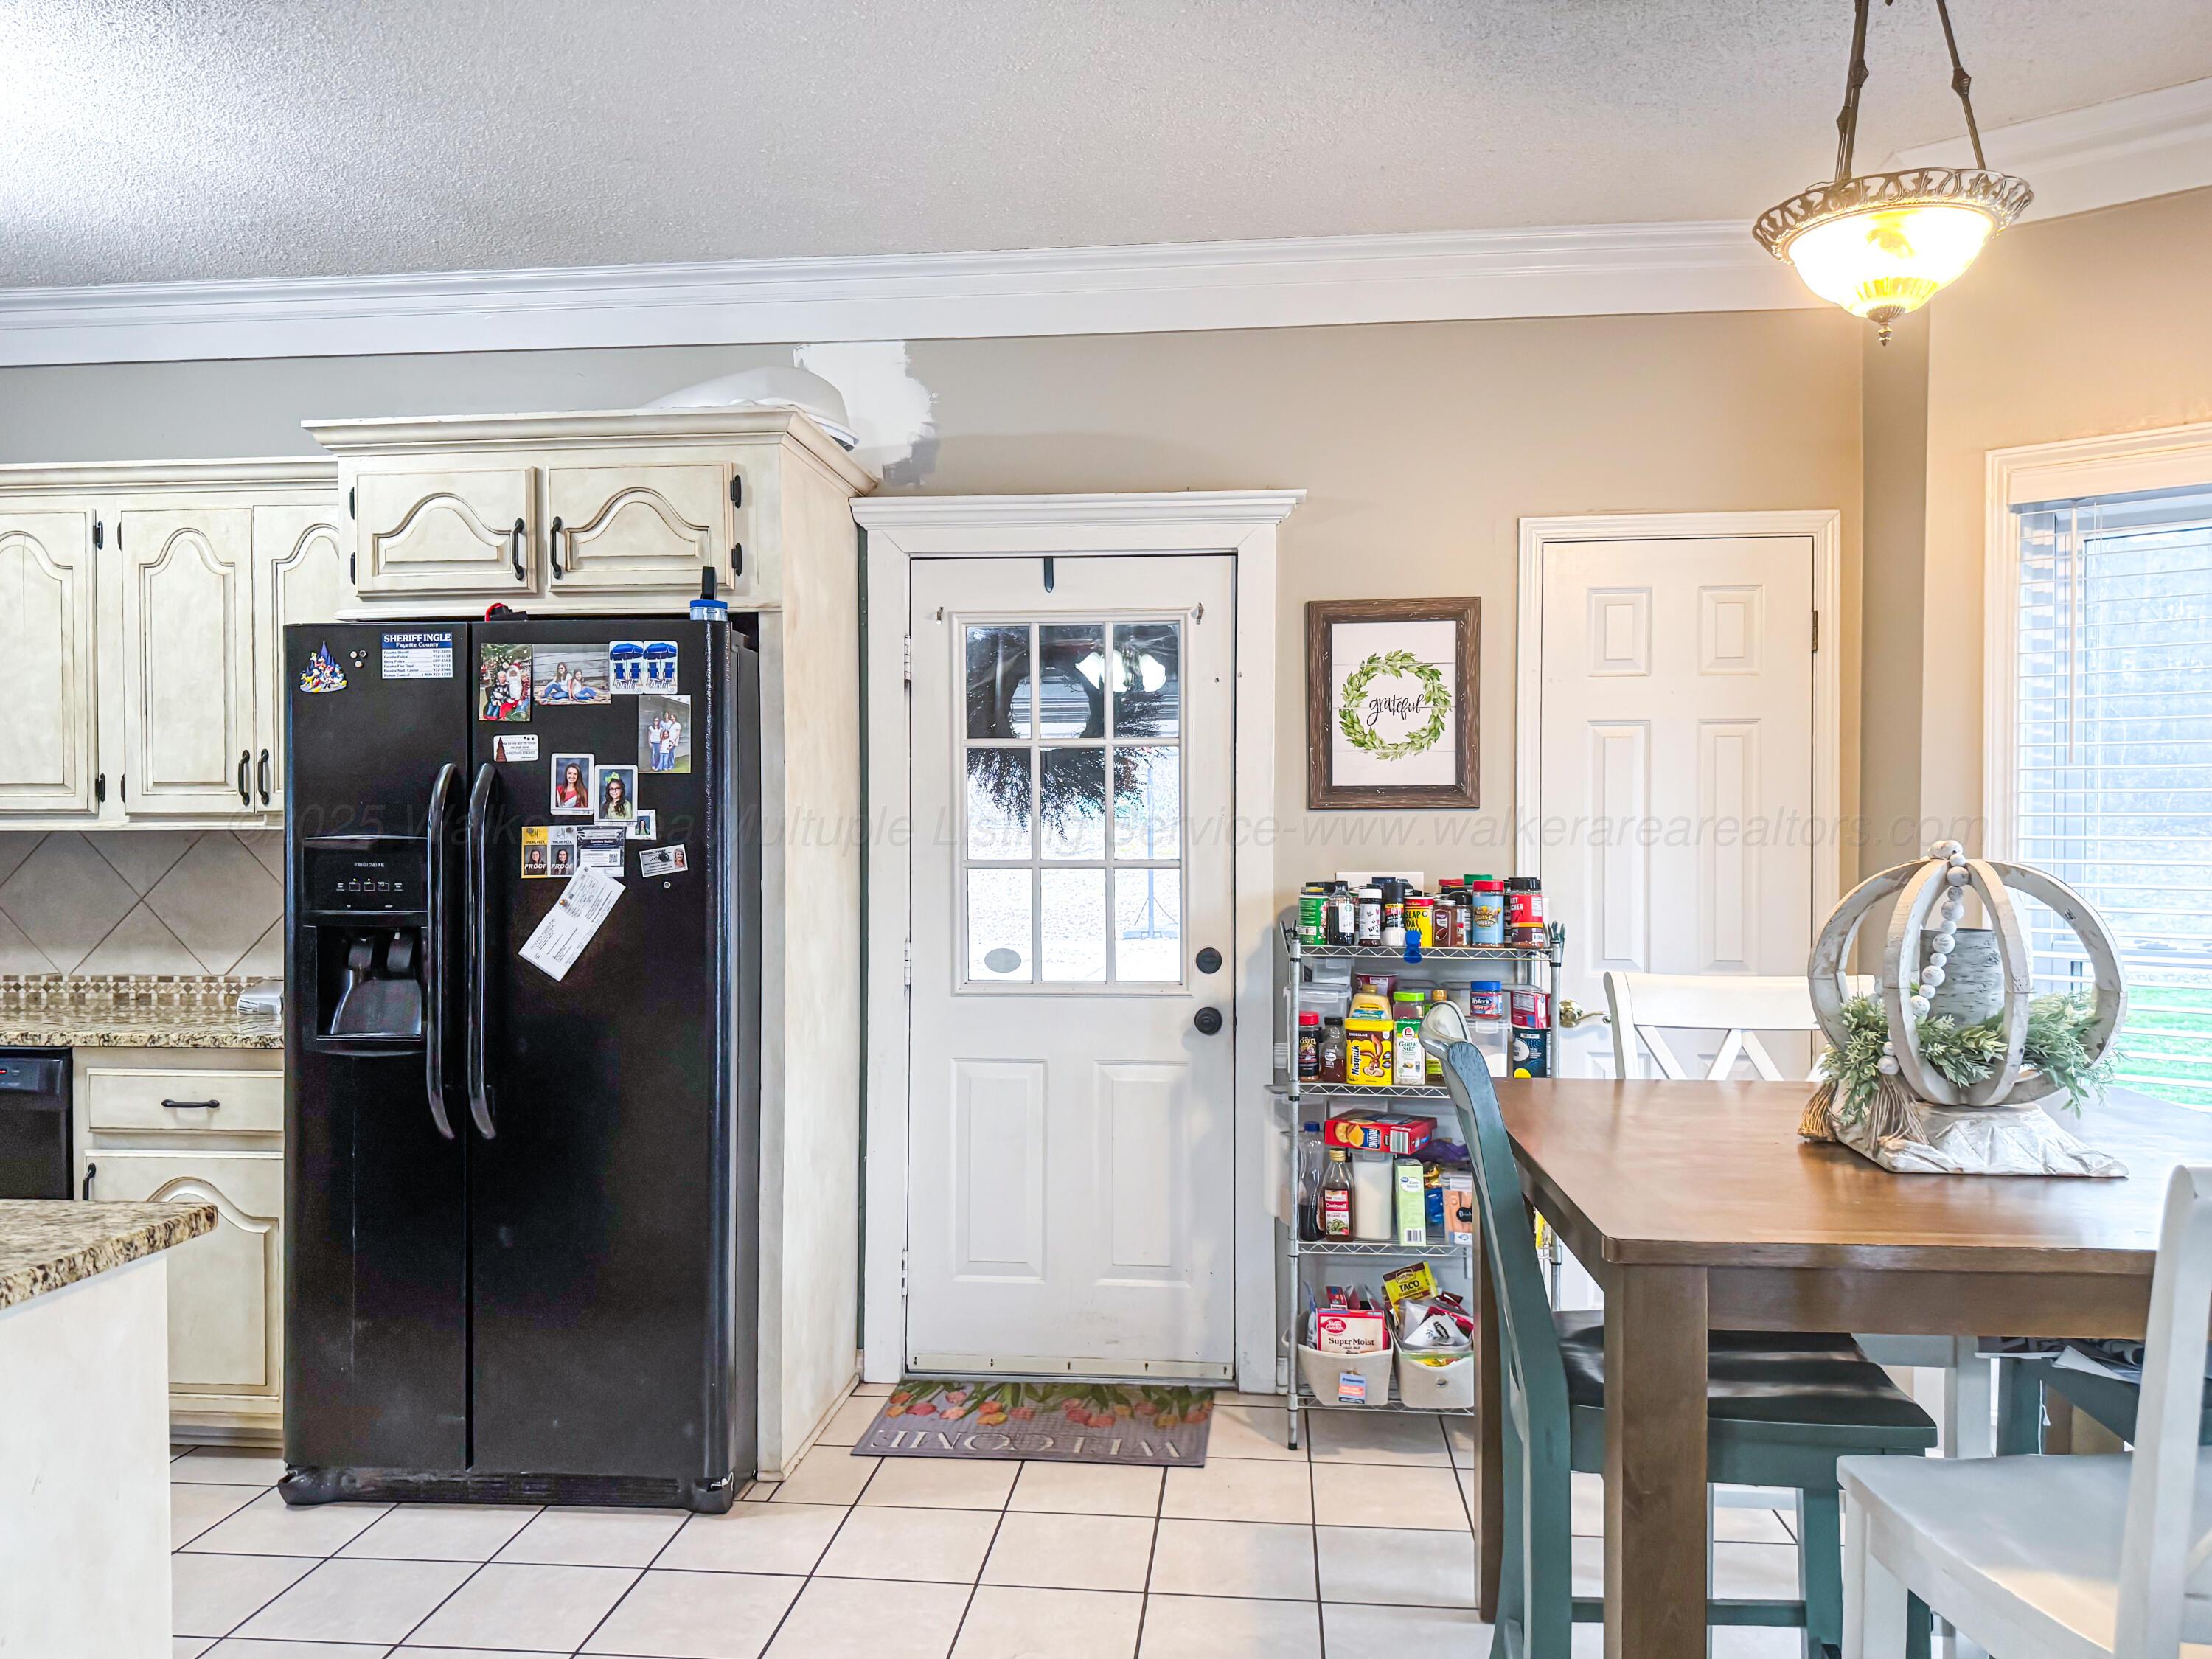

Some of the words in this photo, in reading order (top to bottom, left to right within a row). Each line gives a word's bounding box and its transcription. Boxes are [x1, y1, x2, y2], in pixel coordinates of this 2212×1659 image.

[383, 634, 422, 642] SHERIFF
[1351, 1046, 1362, 1075] Nesquik
[1368, 1128, 1378, 1148] ROUND
[1399, 1280, 1420, 1293] TACO
[1329, 1337, 1352, 1346] Super
